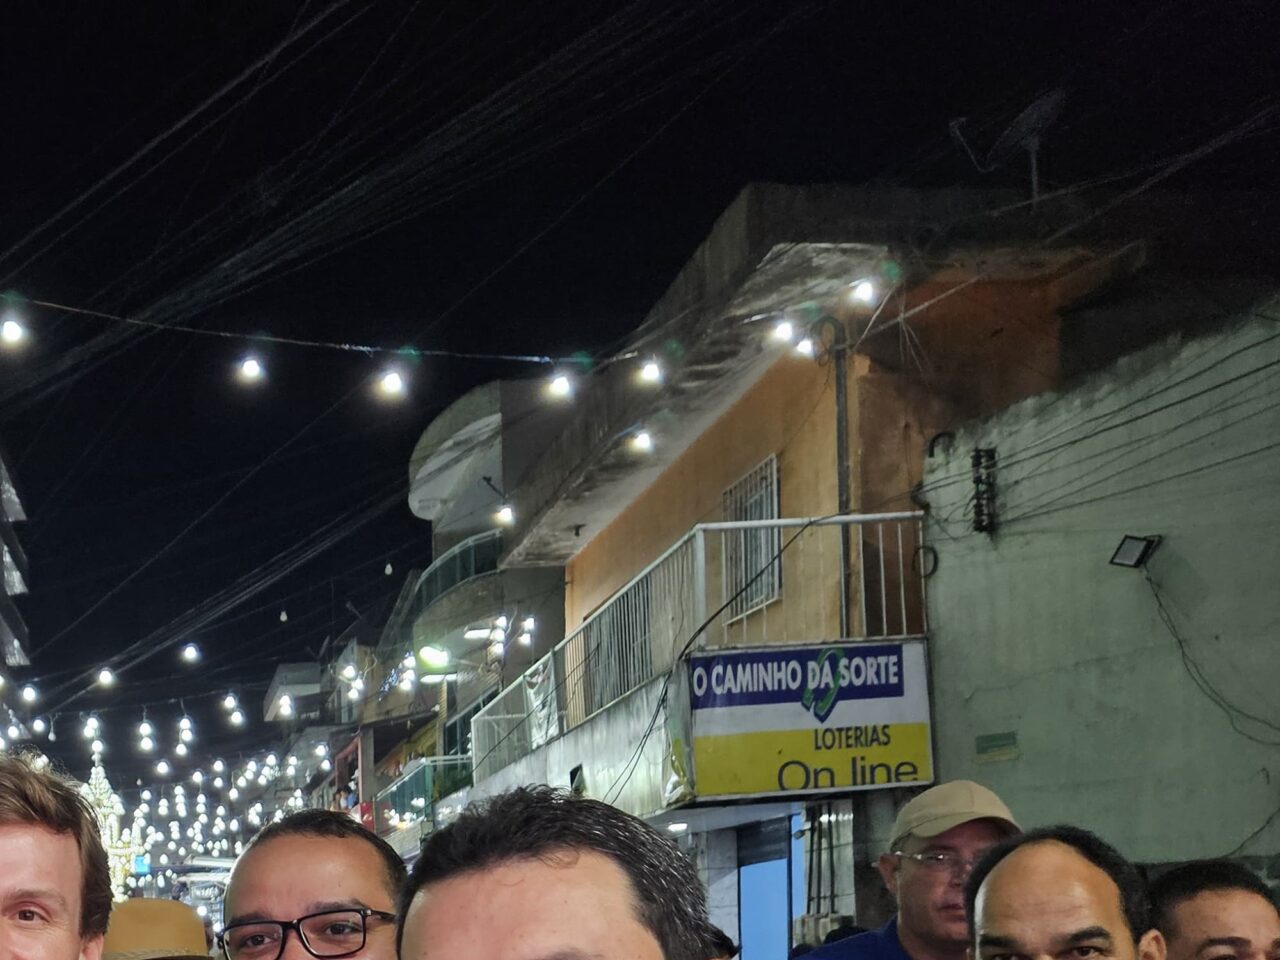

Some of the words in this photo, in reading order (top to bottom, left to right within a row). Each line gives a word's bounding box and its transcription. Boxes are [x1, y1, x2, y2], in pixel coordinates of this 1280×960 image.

[693, 667, 707, 696] O
[711, 660, 802, 695] CAMINHO
[807, 659, 834, 690] DA
[839, 654, 899, 687] SORTE
[814, 724, 891, 751] LOTERIAS
[777, 760, 835, 791] On
[851, 756, 919, 785] line
